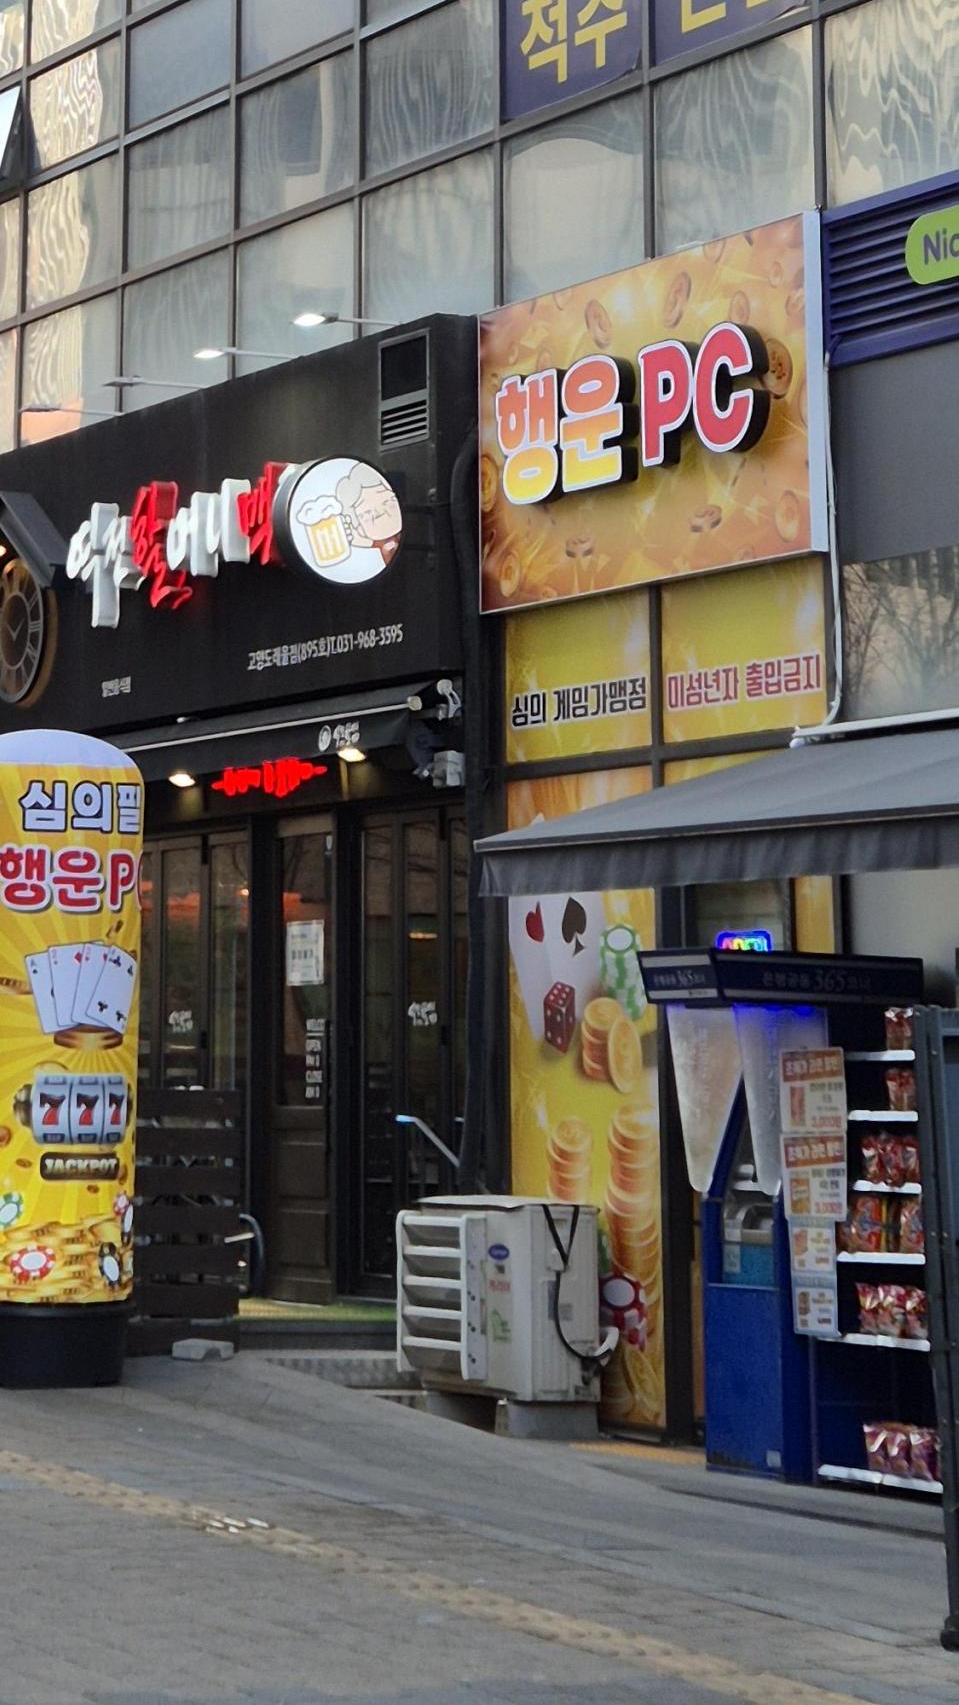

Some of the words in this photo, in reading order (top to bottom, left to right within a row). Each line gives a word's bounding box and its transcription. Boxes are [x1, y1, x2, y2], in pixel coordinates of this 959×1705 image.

[496, 353, 623, 505] 행운
[638, 322, 754, 467] PC
[66, 461, 300, 629] 역전할머니맥
[668, 666, 740, 710] 미성년자
[746, 653, 822, 699] 출입금지
[511, 693, 547, 728] 심의
[44, 1157, 117, 1175] JACKPOT
